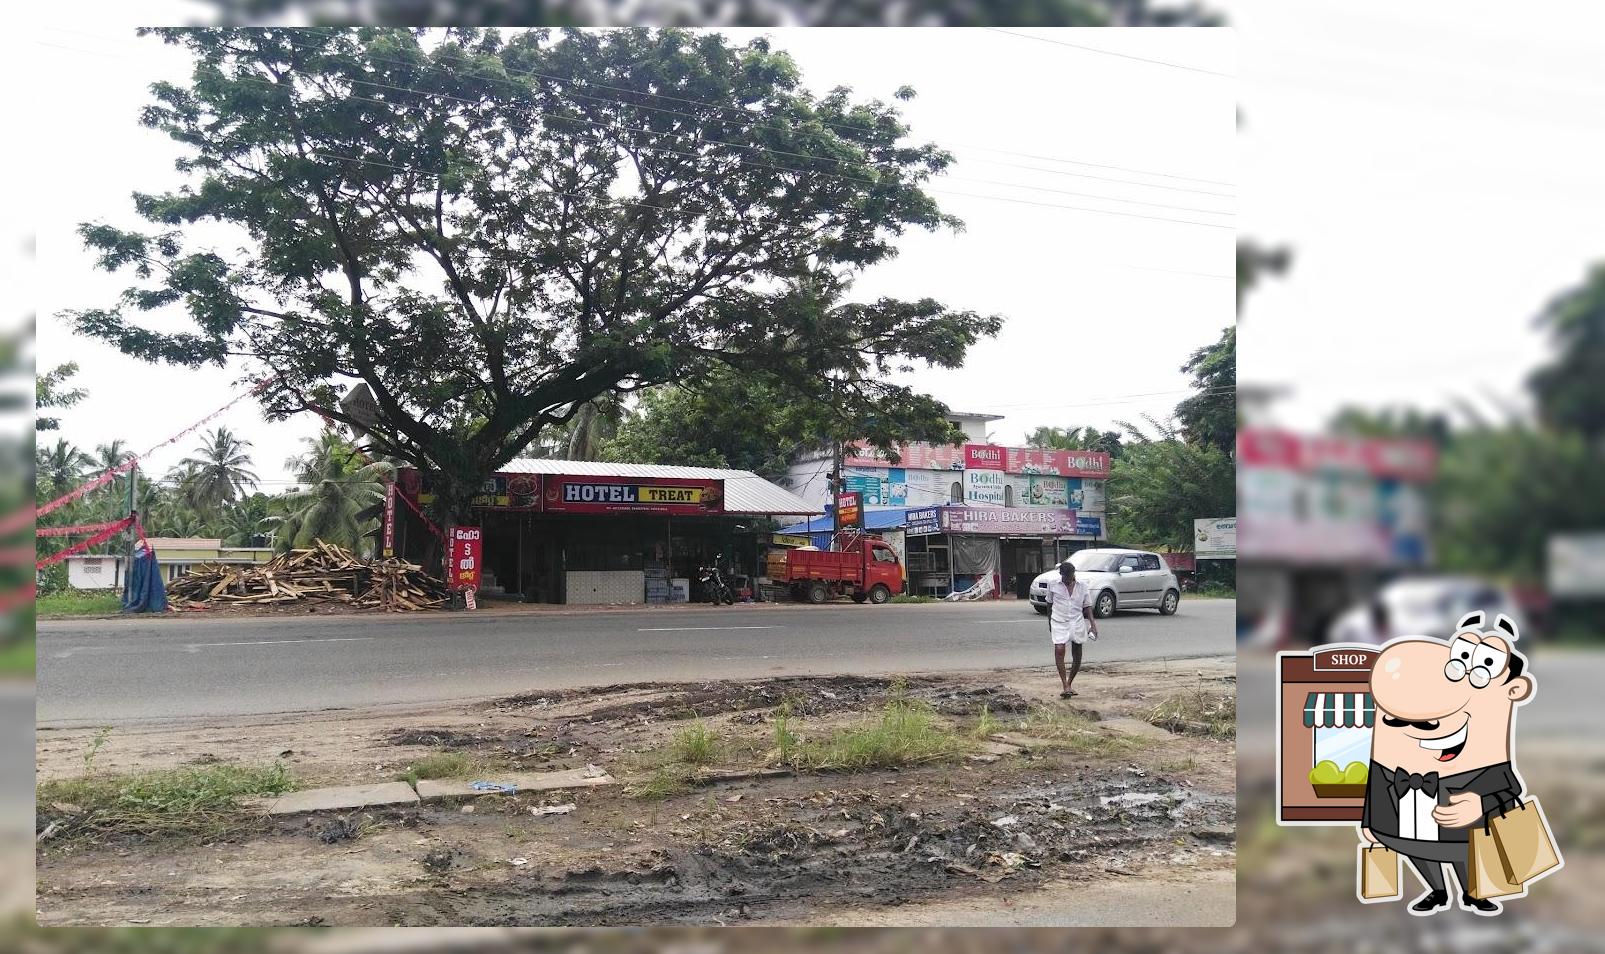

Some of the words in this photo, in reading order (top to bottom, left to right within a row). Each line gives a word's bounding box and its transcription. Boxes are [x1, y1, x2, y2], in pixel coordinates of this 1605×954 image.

[971, 449, 1001, 460] Bodhi
[1067, 456, 1103, 470] Bodhi
[970, 473, 1003, 485] Bodhi
[565, 485, 635, 502] HOTEL
[649, 489, 693, 501] TREAT
[968, 490, 1004, 502] Hospital
[838, 495, 857, 508] HOTEL
[385, 484, 394, 549] HOTEL
[964, 510, 999, 522] HIRA
[1001, 511, 1056, 523] BAKERS
